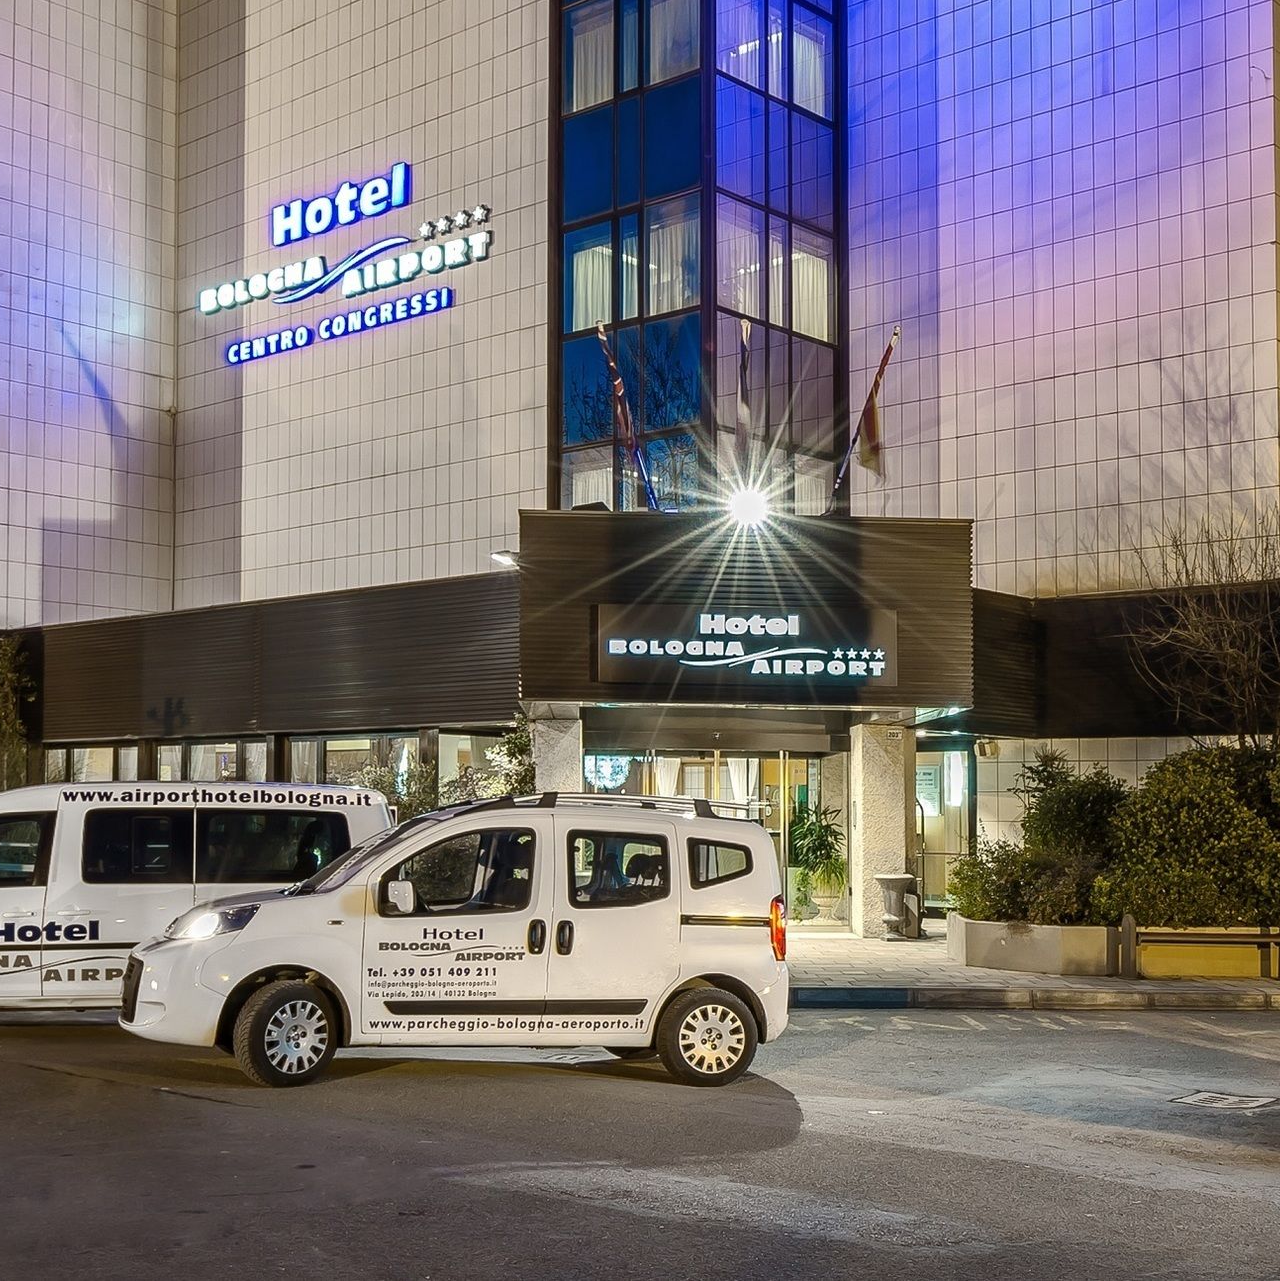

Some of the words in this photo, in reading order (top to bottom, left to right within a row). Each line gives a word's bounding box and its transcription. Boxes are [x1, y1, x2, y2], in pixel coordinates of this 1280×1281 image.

[272, 162, 410, 246] Hotel
[341, 230, 493, 298] AIRPORT
[199, 255, 326, 315] BOLOGNA
[227, 326, 313, 365] CENTRO
[318, 286, 454, 340] CONGRESSI
[698, 613, 800, 636] Hotel
[608, 640, 745, 656] BOLOGNA
[750, 659, 886, 677] AIRPORT
[62, 787, 372, 808] www.airporthotelbologna.it
[423, 928, 484, 940] Hotel
[378, 942, 451, 951] BOLOGNA
[455, 952, 525, 961] AIRPORT
[367, 968, 387, 977] Tel.
[392, 968, 415, 977] +39
[420, 968, 442, 977] 051
[448, 968, 470, 976] 409
[476, 967, 497, 976] 211
[369, 1017, 644, 1033] www.parcheggio-bologna-aeroporto.it
